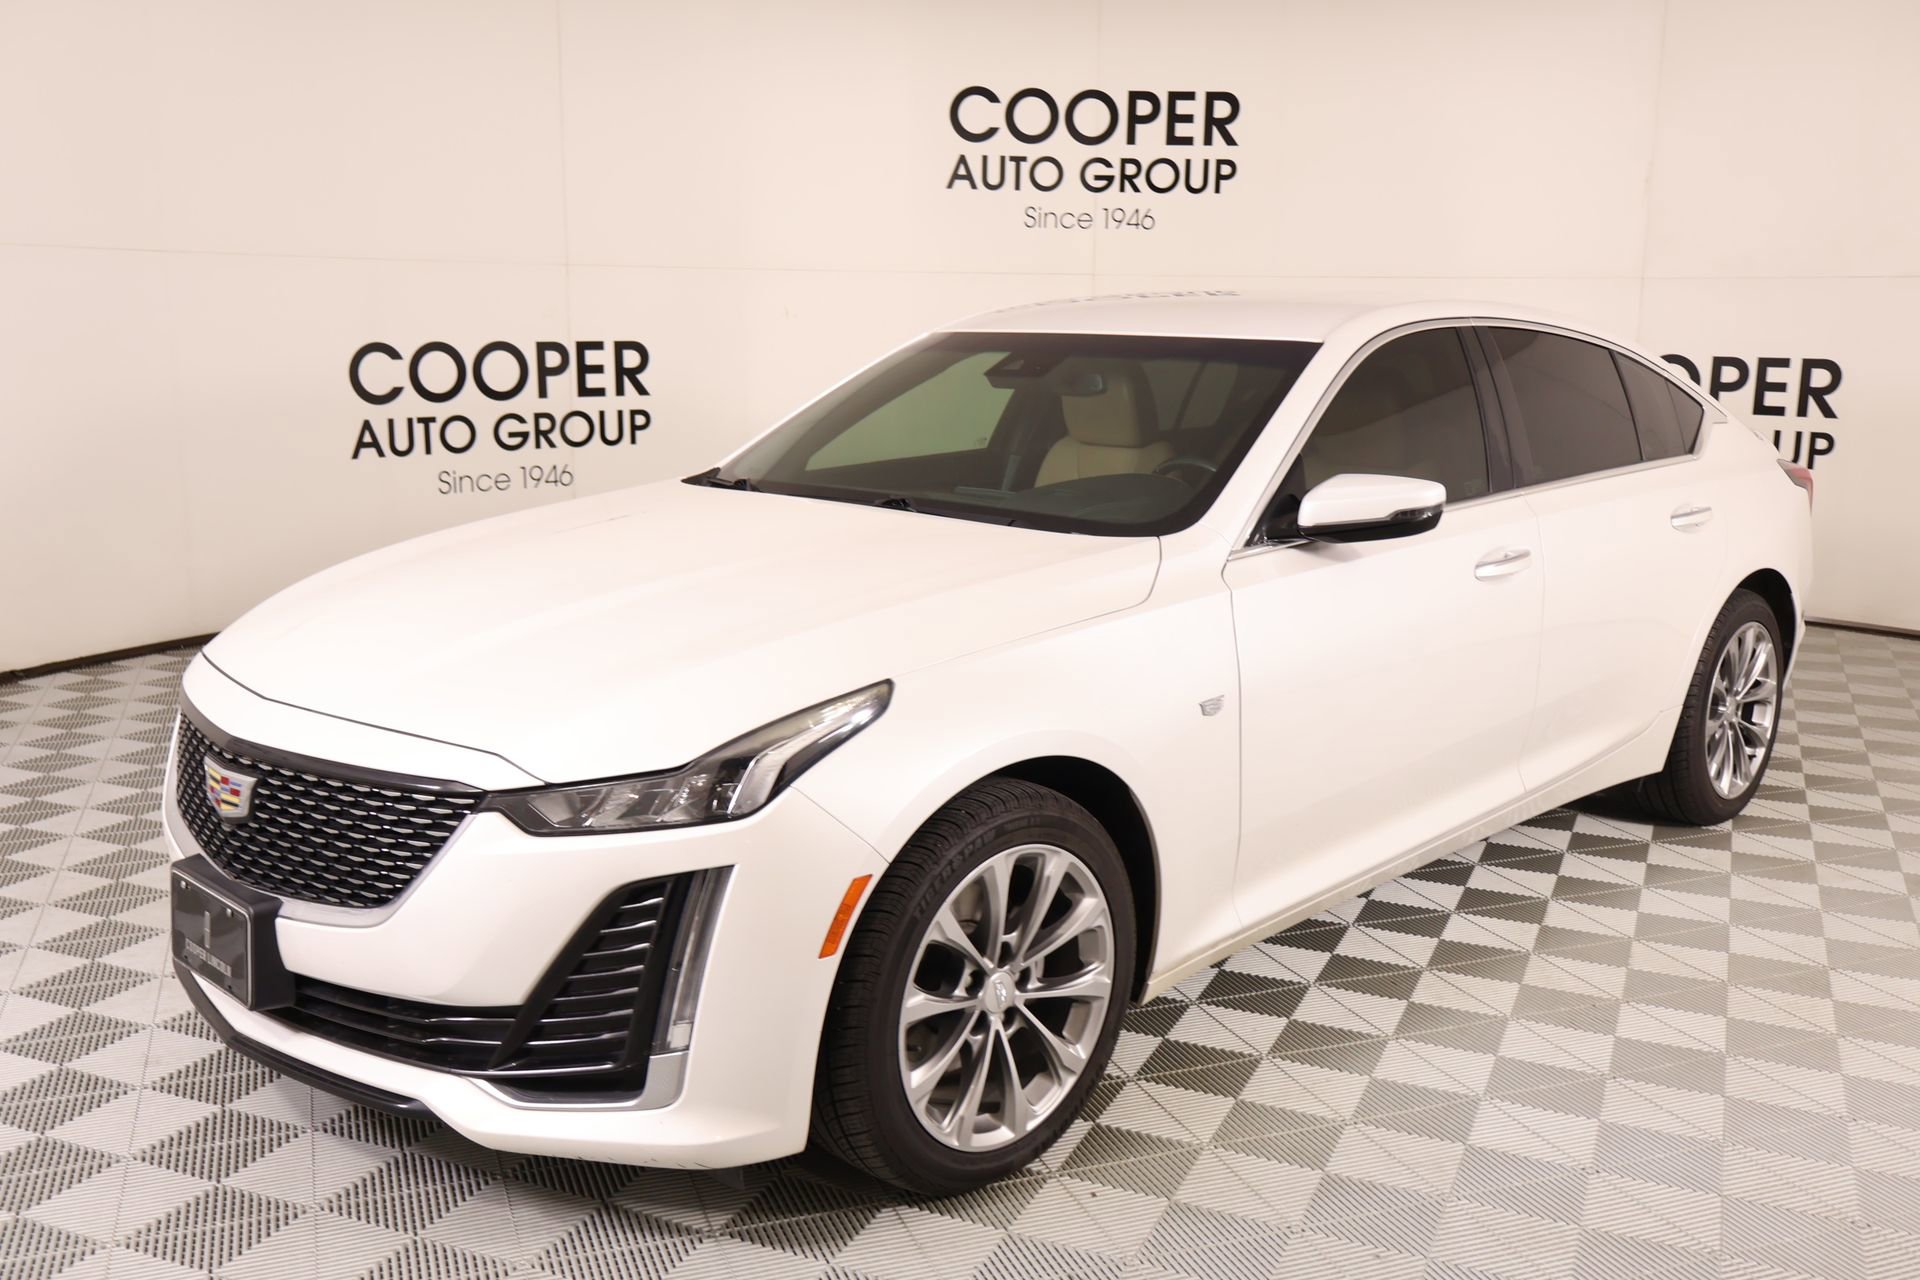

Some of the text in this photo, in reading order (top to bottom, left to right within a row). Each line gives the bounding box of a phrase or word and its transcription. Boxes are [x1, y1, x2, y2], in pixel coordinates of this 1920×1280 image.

[949, 85, 1241, 147] COOPER
[946, 154, 1237, 195] AUTO GROUP
[1023, 205, 1156, 231] Since 1946
[348, 340, 651, 406] COOPER
[351, 409, 652, 460] AUTO GROUP
[437, 463, 575, 496] Since 1946
